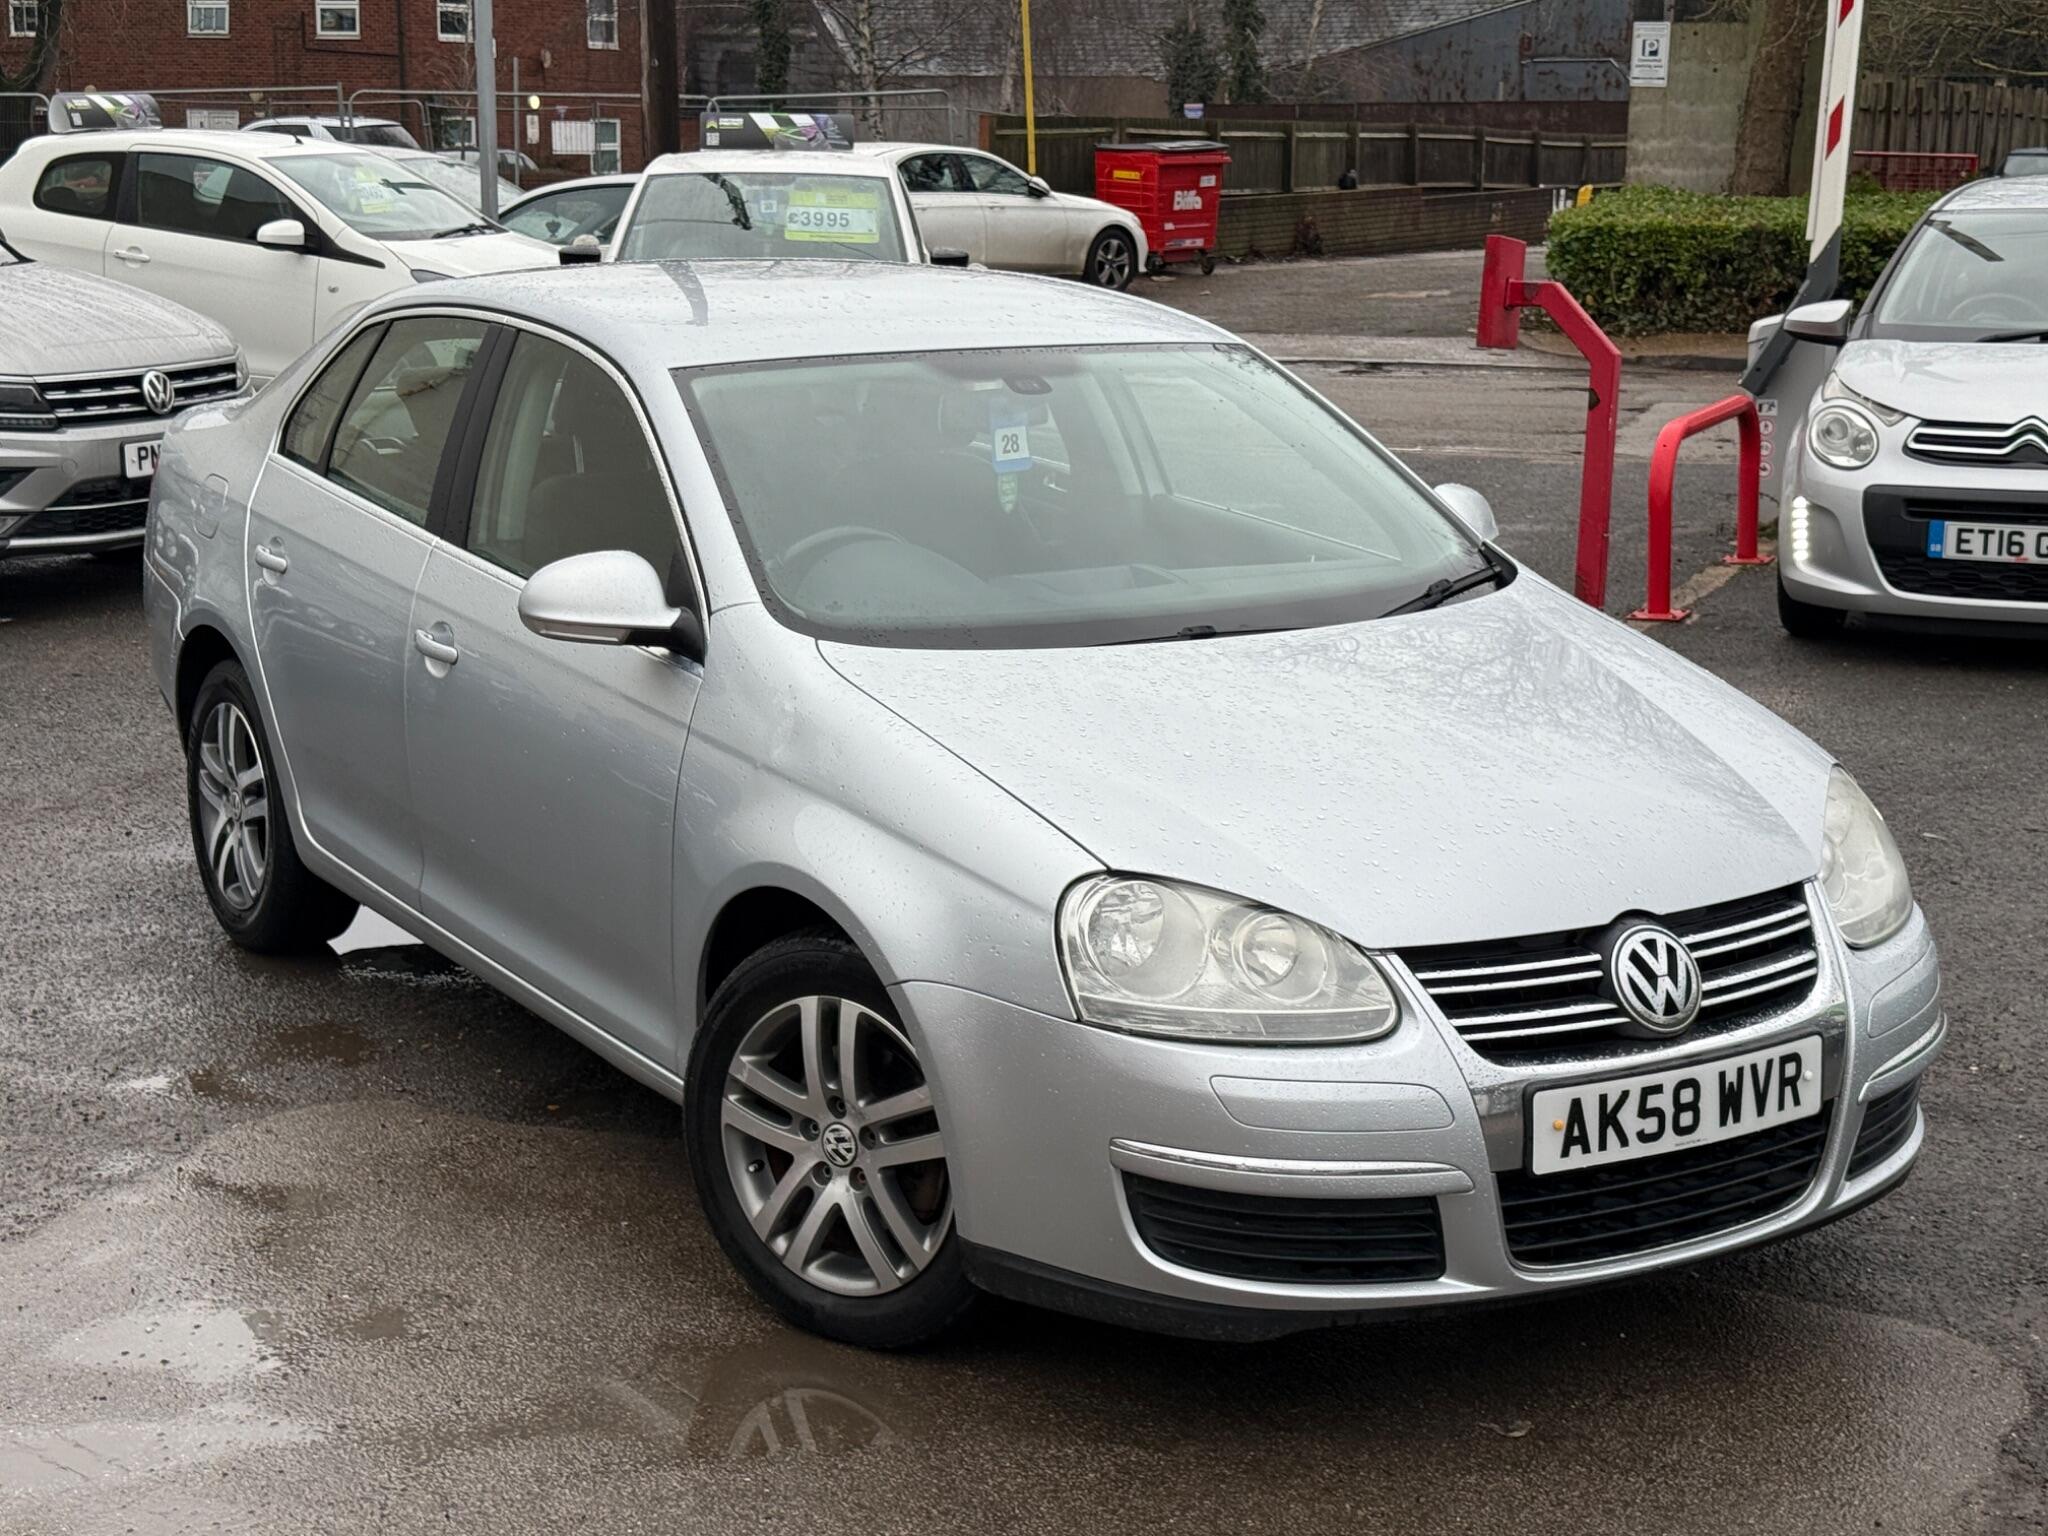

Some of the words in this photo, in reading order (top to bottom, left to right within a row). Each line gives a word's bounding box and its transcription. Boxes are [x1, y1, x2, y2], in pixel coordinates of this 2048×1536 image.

[788, 210, 850, 228] £3995
[1001, 433, 1020, 455] 28
[1955, 527, 2026, 557] ET16
[1559, 1077, 1702, 1160] AK58
[1717, 1050, 1804, 1129] WVR
